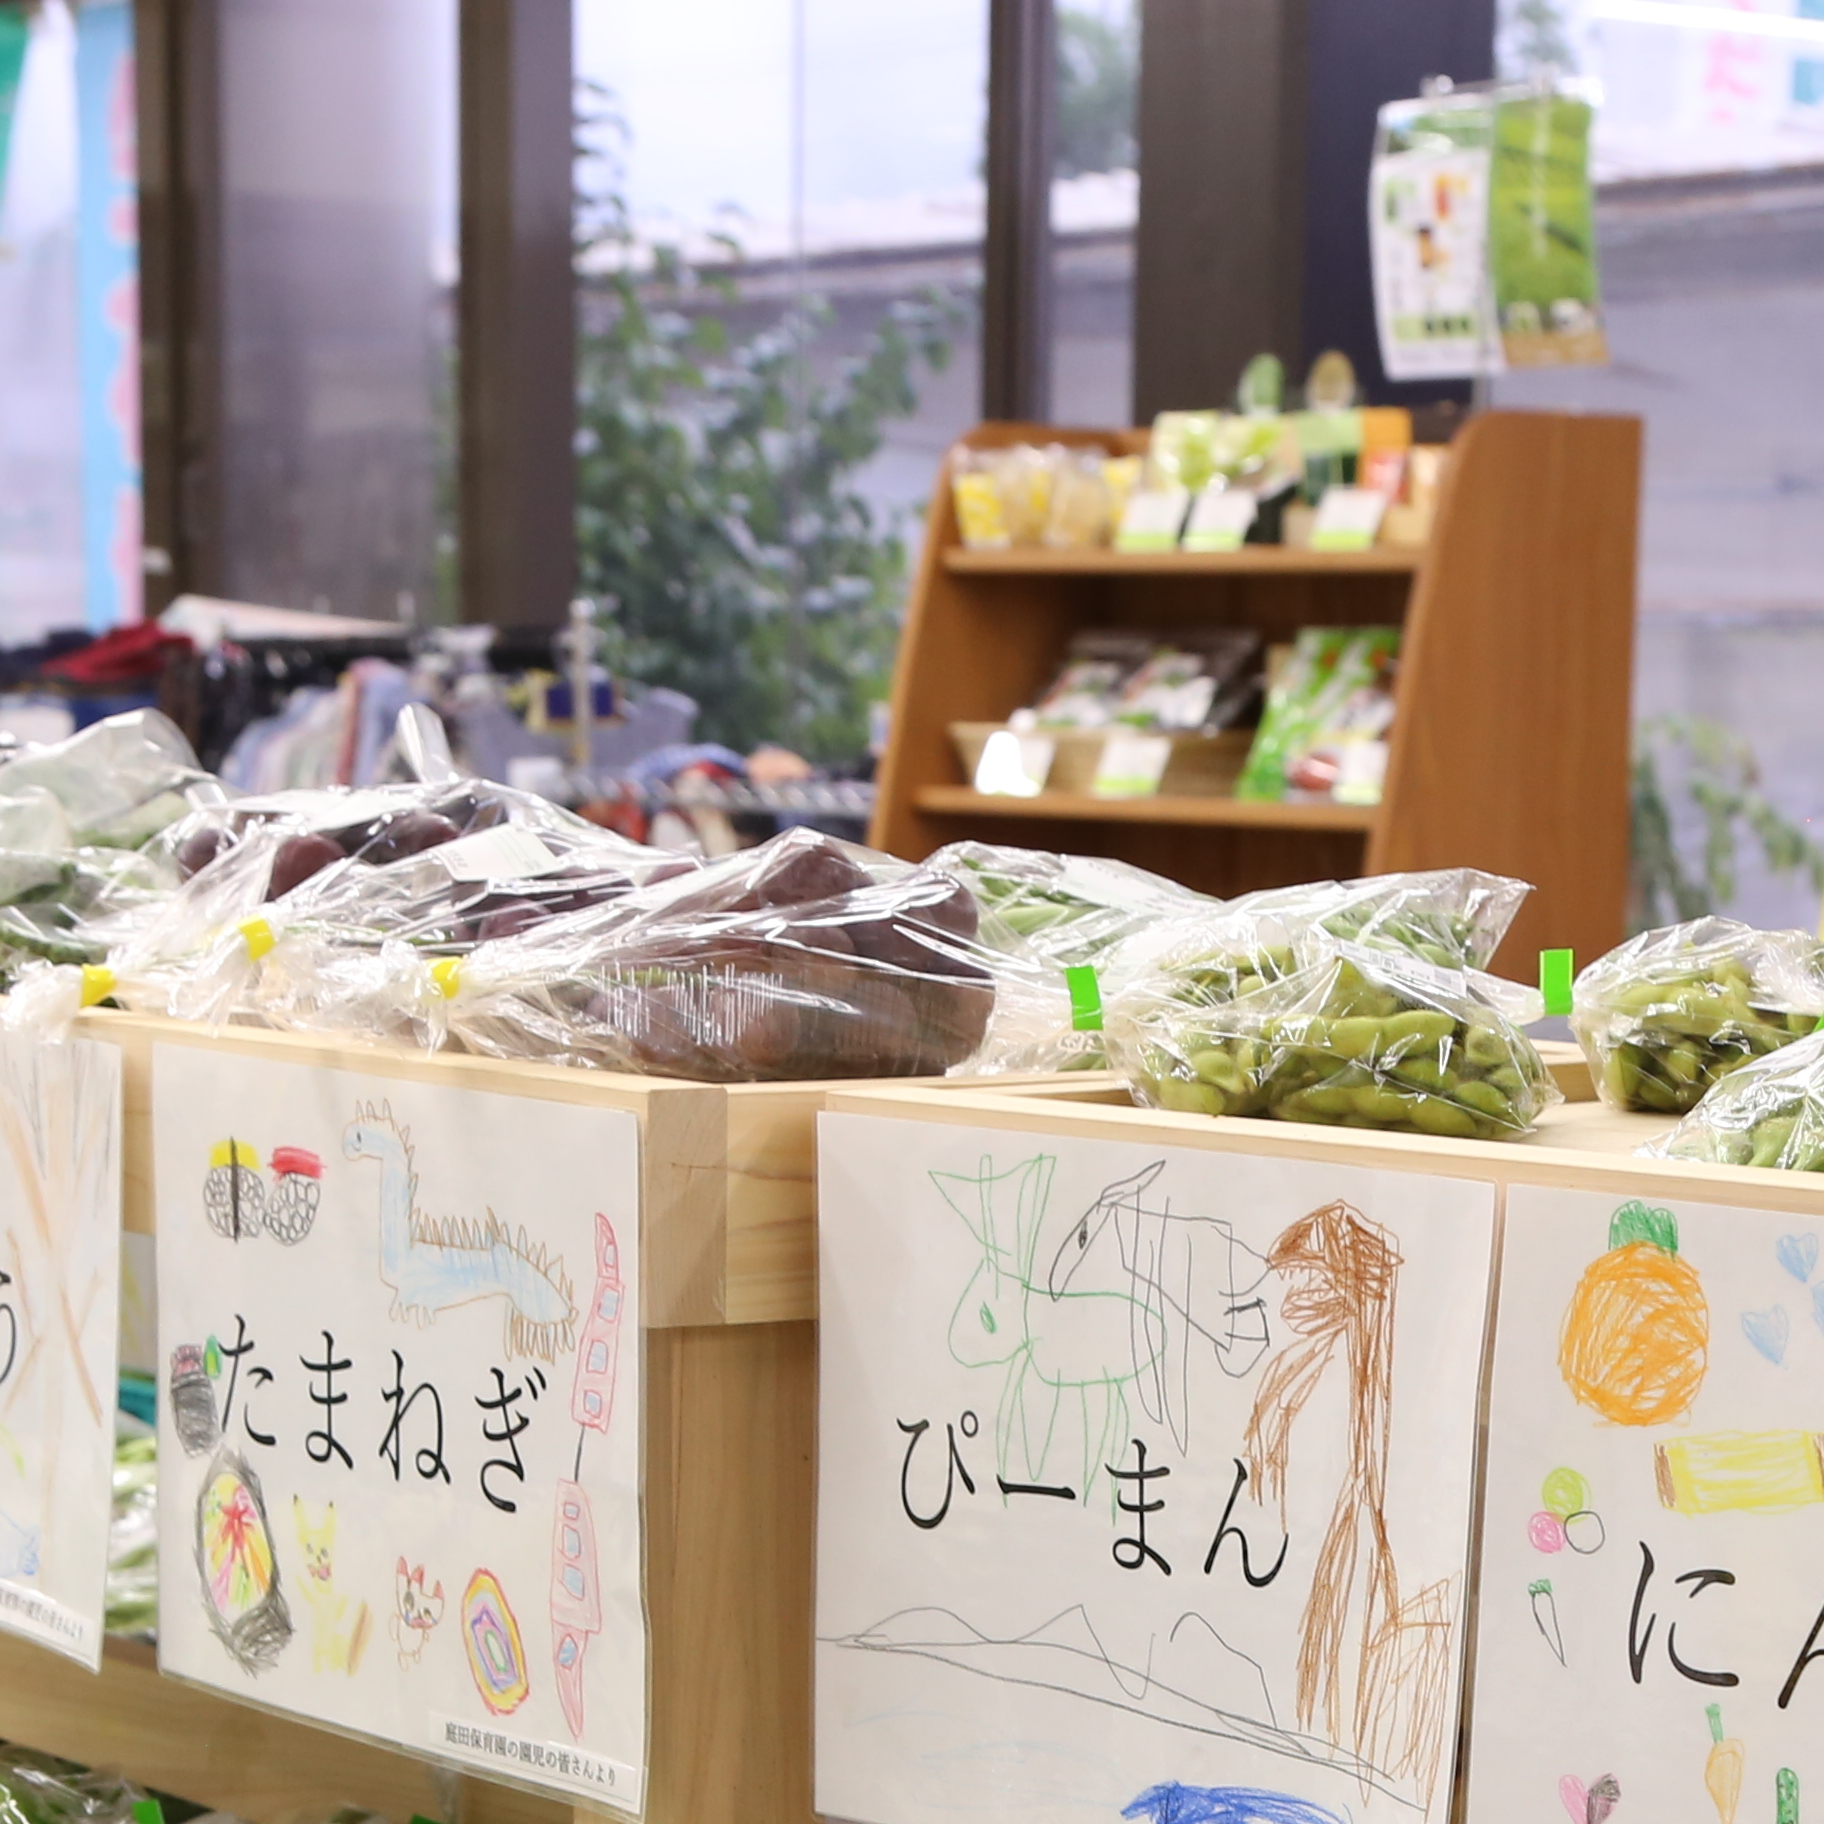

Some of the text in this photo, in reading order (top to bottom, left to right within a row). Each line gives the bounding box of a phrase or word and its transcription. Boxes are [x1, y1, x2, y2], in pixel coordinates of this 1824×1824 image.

[218, 1314, 547, 1514] たまねぎ
[896, 1409, 1290, 1589] ぴーまん
[444, 1721, 617, 1789] 庭田保育園の園児の皆さんより
